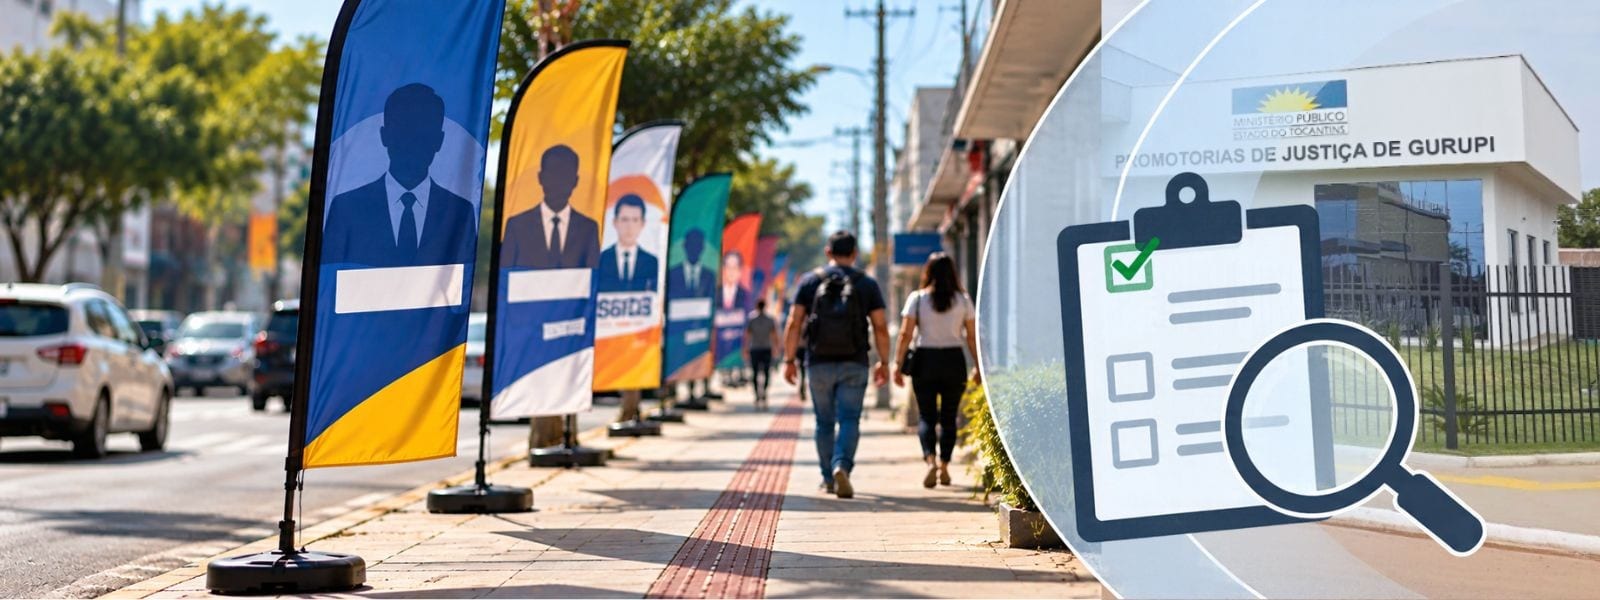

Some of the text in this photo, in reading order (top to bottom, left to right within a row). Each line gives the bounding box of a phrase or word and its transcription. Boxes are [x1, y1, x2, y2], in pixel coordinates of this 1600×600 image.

[1233, 111, 1345, 127] MINISTÉRIO PÚBLICO
[1233, 125, 1346, 141] ESTADO DO TOCANTINS
[1251, 146, 1277, 163] DE
[1282, 143, 1368, 164] JUSTIÇA
[1373, 140, 1401, 158] DE
[1408, 136, 1495, 156] GURUPI
